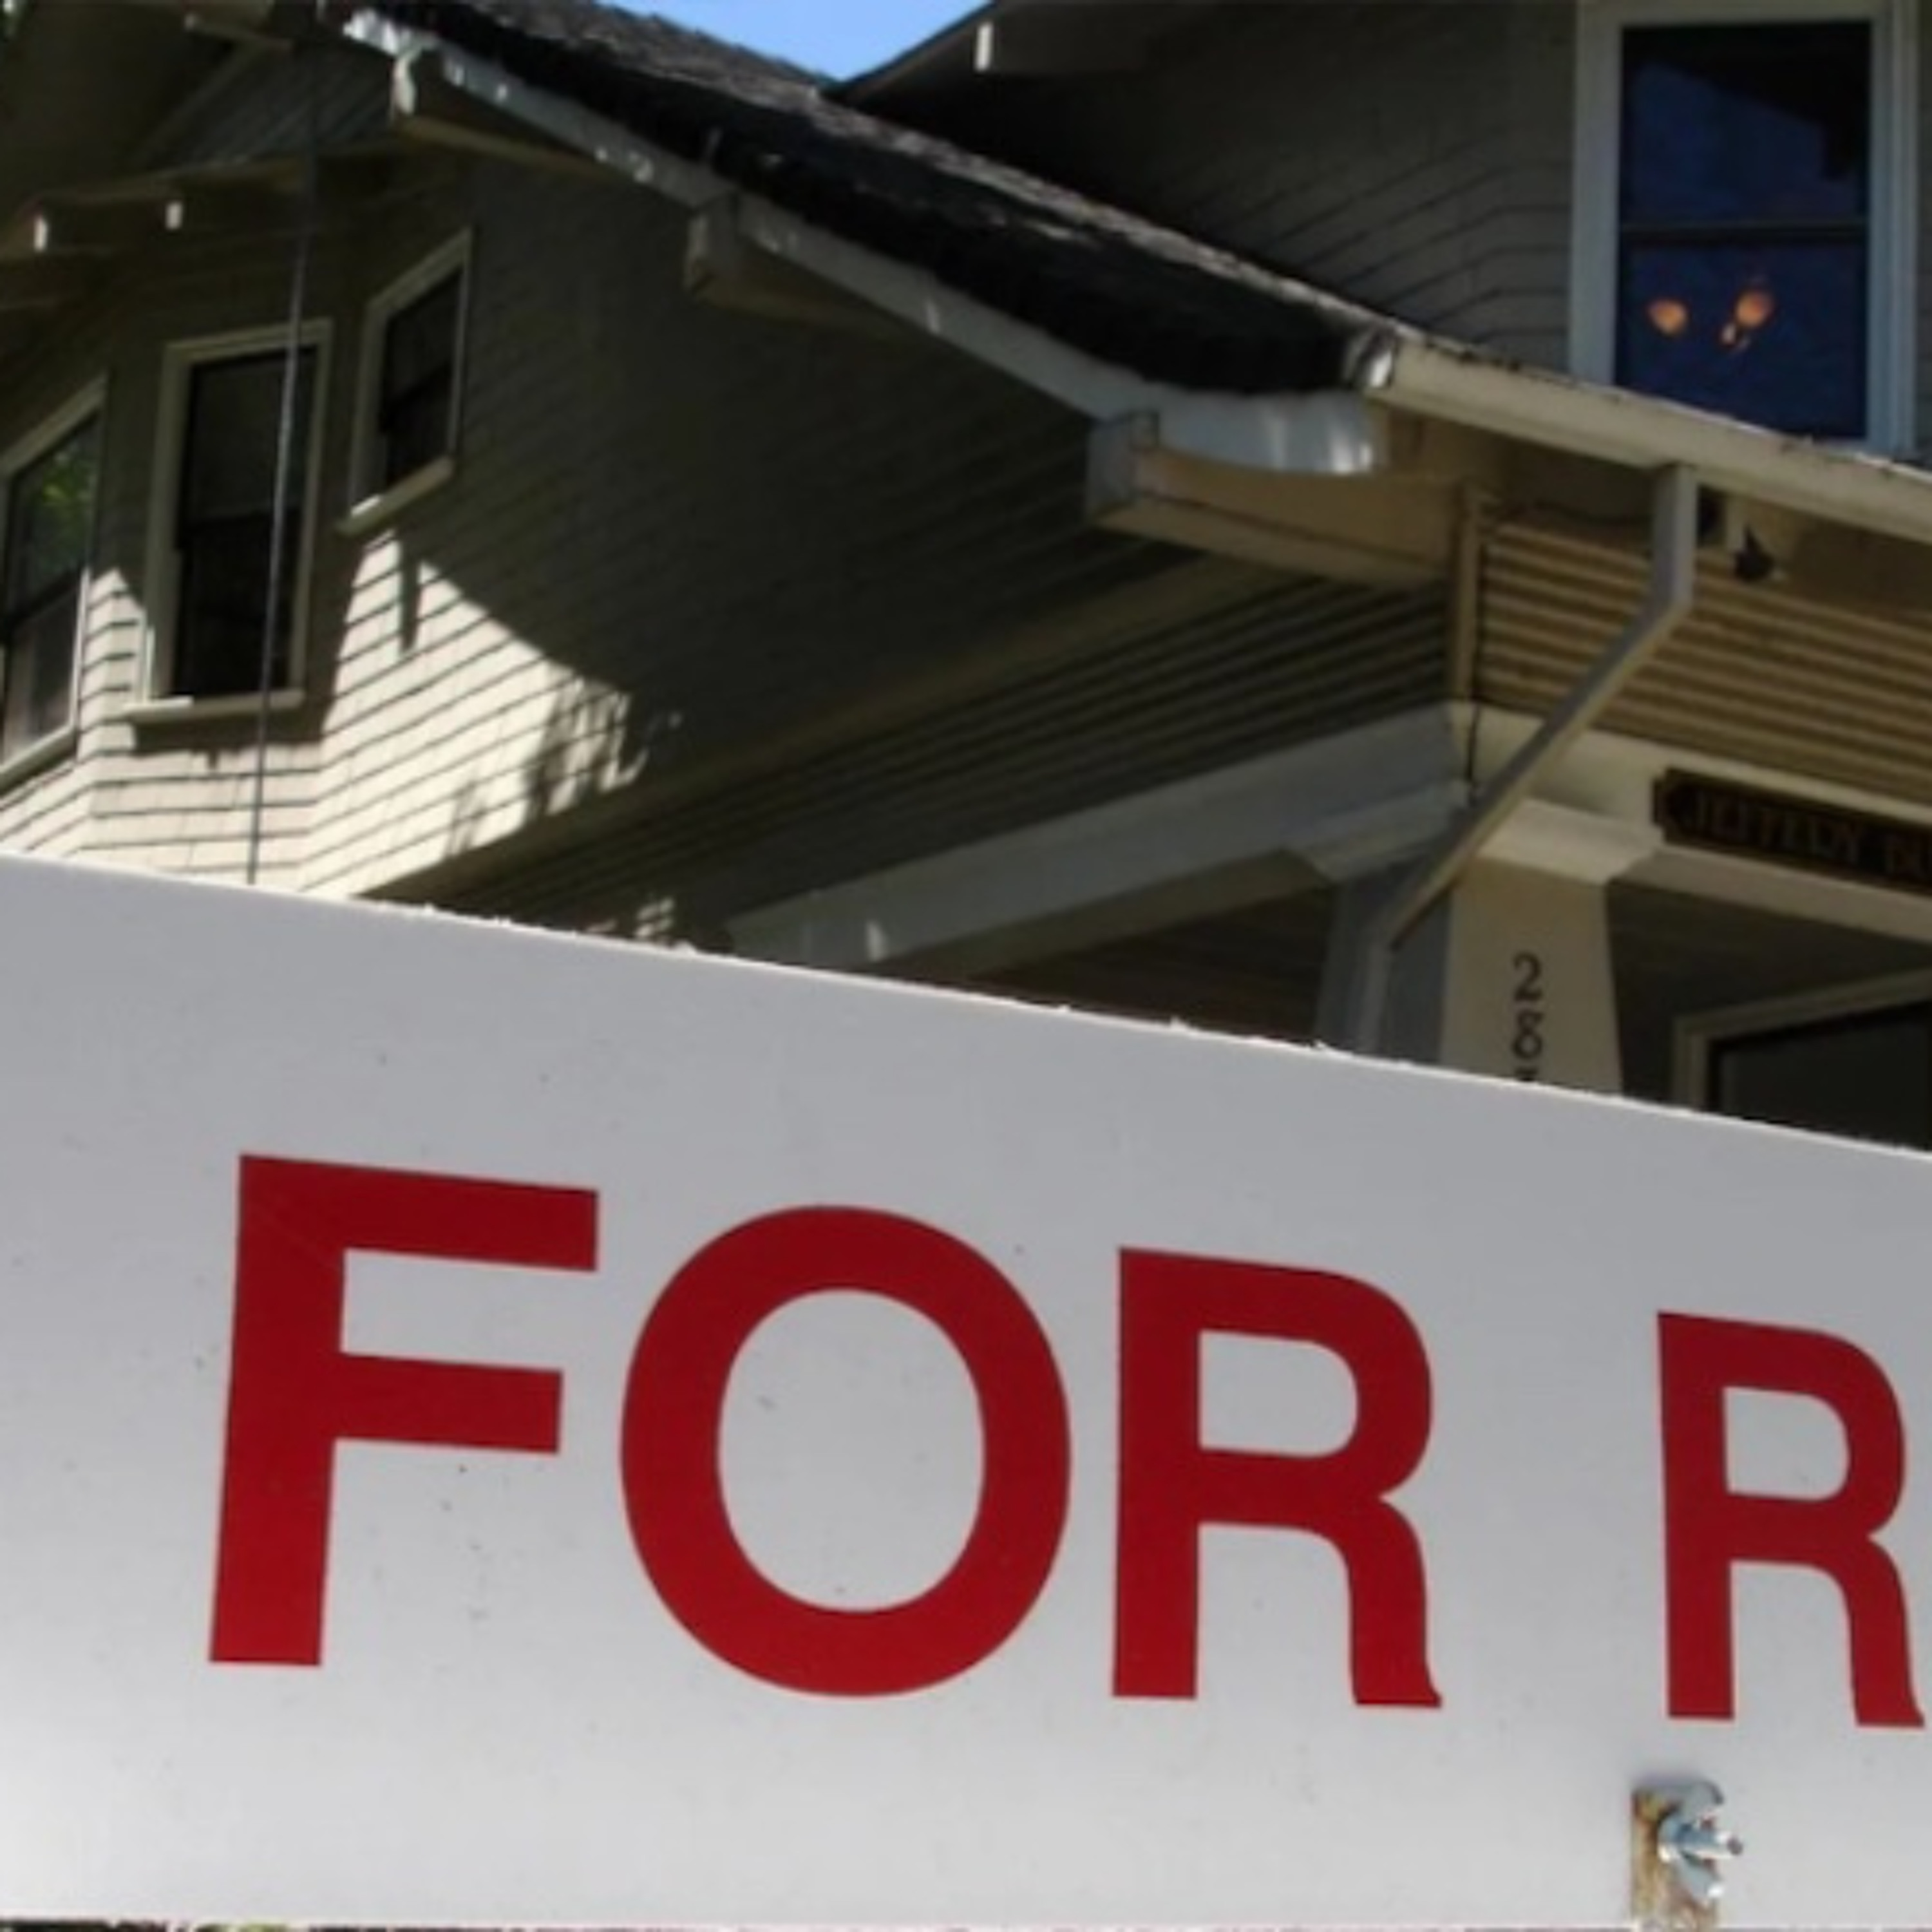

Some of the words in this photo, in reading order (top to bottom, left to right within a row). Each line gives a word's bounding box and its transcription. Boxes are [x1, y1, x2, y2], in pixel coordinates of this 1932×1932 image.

[1512, 951, 1544, 1083] 28
[209, 1154, 1442, 1710] FOR
[1656, 1311, 1926, 1728] R
